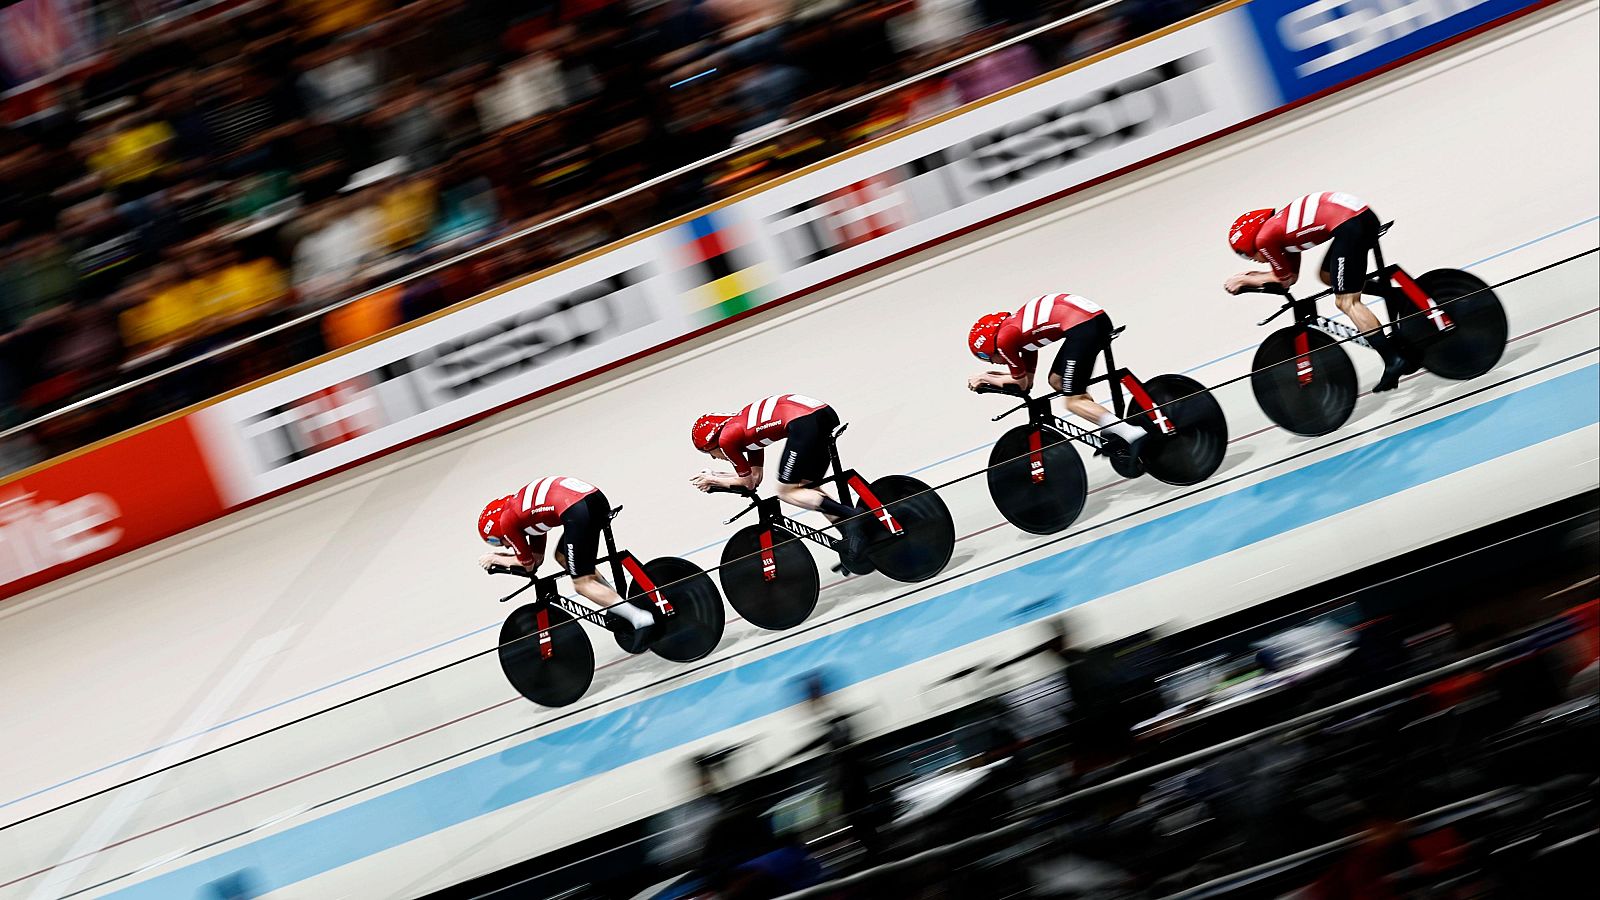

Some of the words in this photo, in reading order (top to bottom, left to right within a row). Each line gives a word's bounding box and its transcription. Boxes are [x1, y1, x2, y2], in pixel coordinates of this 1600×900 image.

[973, 335, 987, 349] DEN
[755, 419, 782, 433] postnord
[531, 505, 554, 515] postnord
[784, 517, 831, 548] CANYON
[560, 597, 606, 627] CANYON
